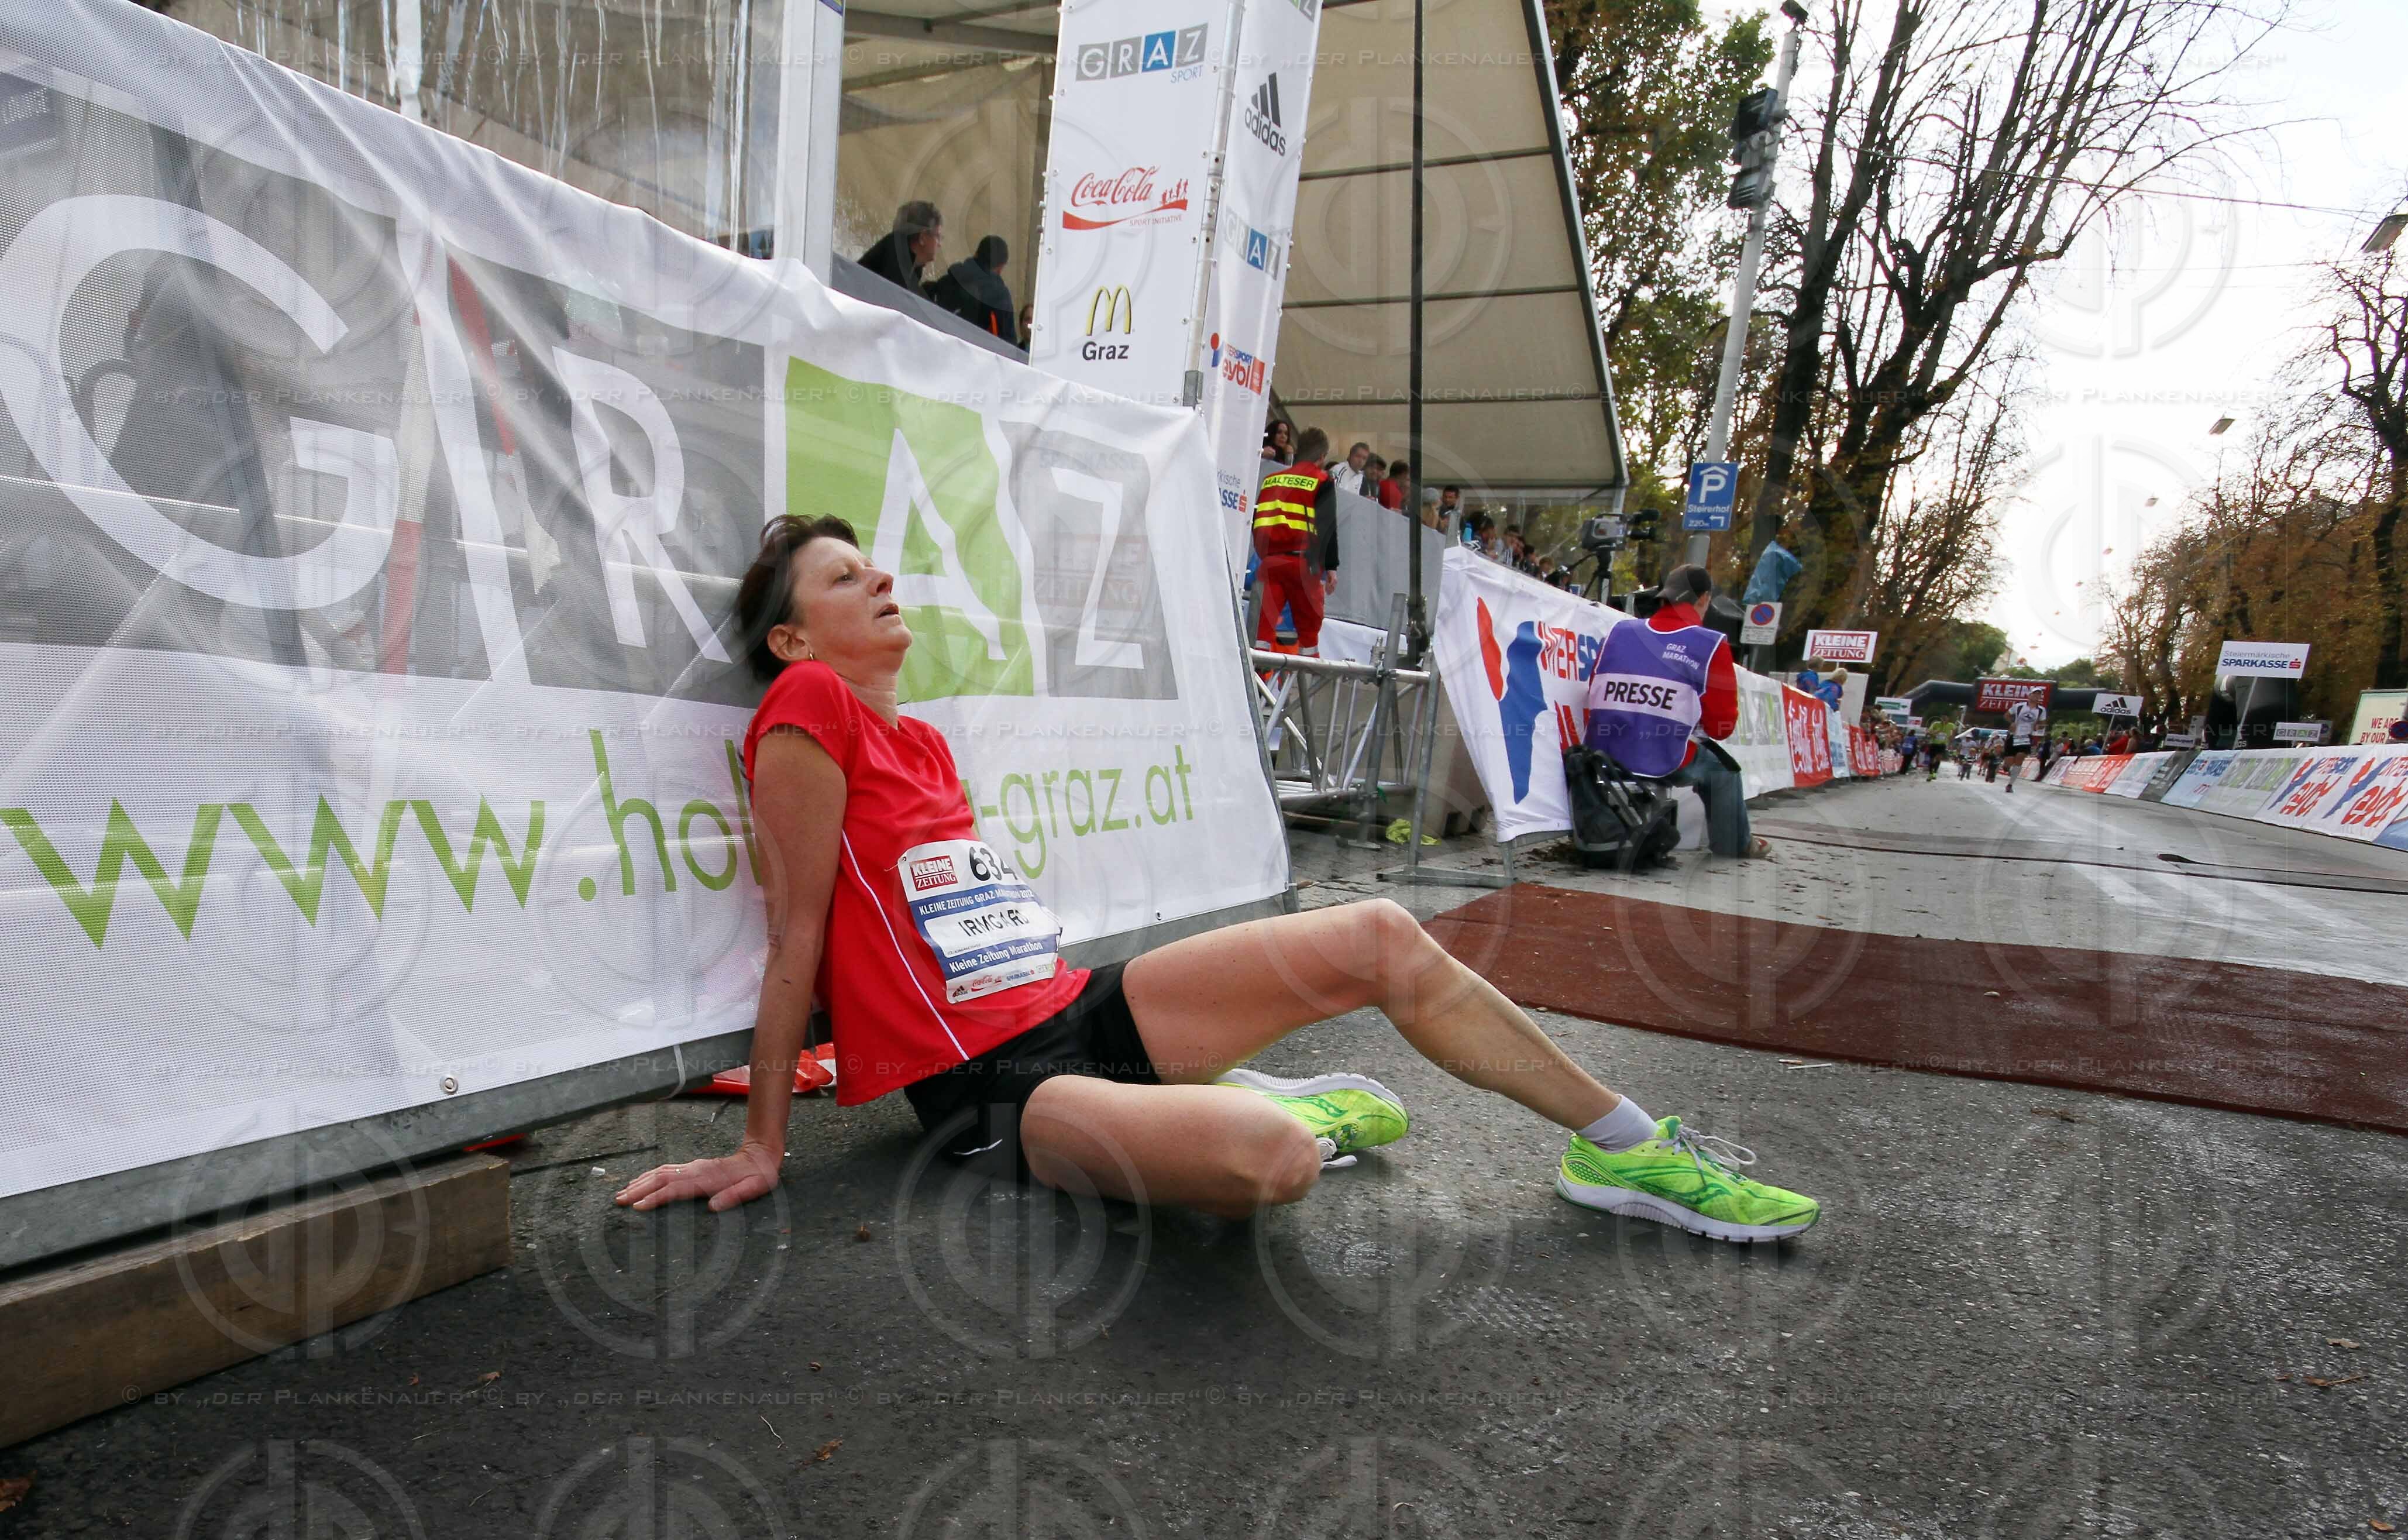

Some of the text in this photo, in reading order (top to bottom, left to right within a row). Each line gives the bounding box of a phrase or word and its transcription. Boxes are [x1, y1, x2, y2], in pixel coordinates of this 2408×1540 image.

[1081, 29, 1202, 77] GRAZ
[1170, 64, 1204, 84] SPORT
[1244, 107, 1287, 157] adidas
[1082, 341, 1129, 360] Graz
[1264, 477, 1315, 489] MALTESER
[1688, 504, 1730, 513] Steirerhof
[1666, 642, 1688, 654] GRAZ
[1815, 635, 1867, 647] KLEINE
[1537, 621, 1605, 682] INTERSP
[1661, 651, 1701, 671] MARATHON
[1812, 648, 1864, 658] ZEITUNG
[2222, 658, 2289, 669] SPARKASSE
[1604, 680, 1677, 711] PRESSE
[2100, 706, 2131, 715] adidas
[2371, 717, 2383, 729] WE
[2360, 732, 2386, 744] BY OUR
[0, 729, 1193, 949] www.hol-graz.at
[911, 858, 952, 877] KLEINE
[916, 875, 956, 889] ZEITUNG
[919, 902, 947, 916] KLEINE
[947, 896, 974, 911] ZEITUNG
[975, 890, 995, 903] GRAZ
[949, 959, 978, 973] Kleine
[977, 950, 1010, 964] Zeitung
[1008, 941, 1044, 956] Marathon
